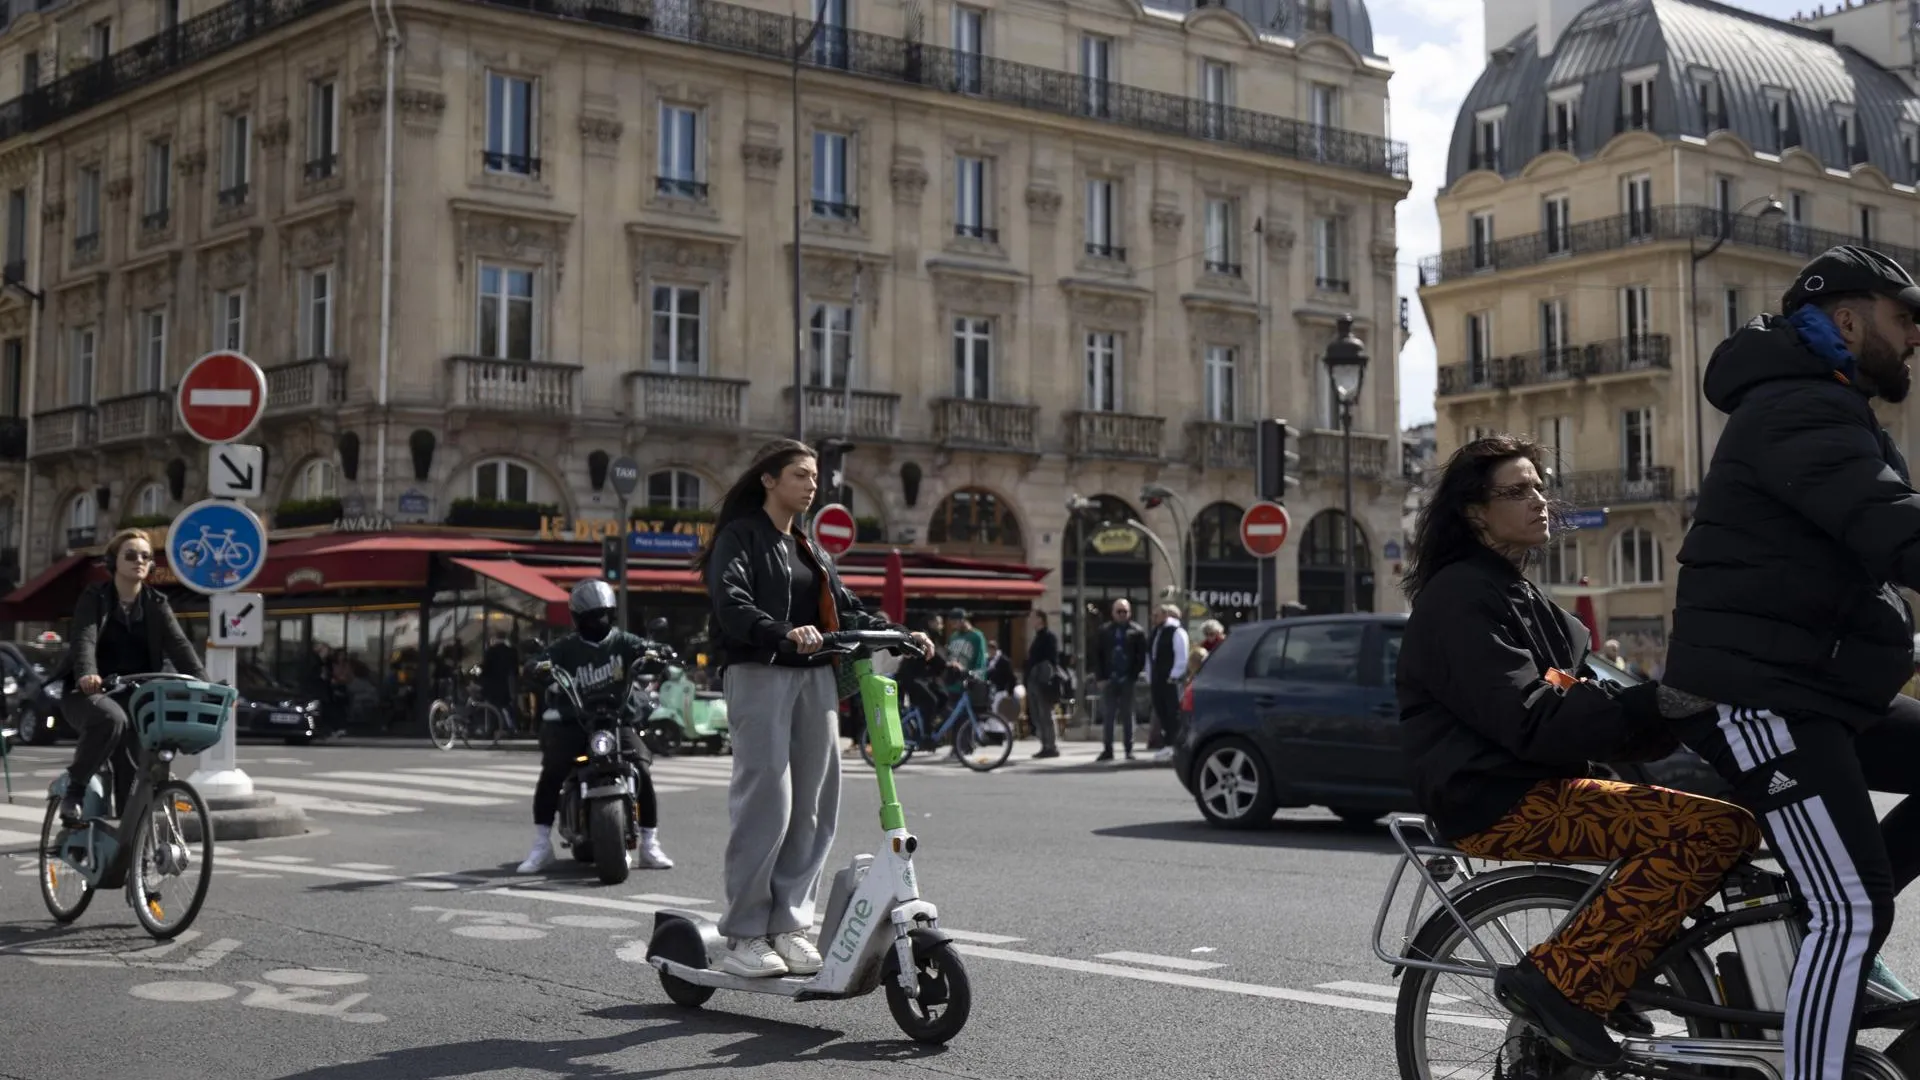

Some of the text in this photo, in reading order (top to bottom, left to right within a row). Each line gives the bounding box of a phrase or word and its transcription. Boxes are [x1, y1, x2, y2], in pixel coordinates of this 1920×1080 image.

[614, 467, 637, 478] TAXI
[540, 516, 565, 541] LE
[1767, 779, 1798, 795] adidas
[831, 898, 874, 963] Lime
